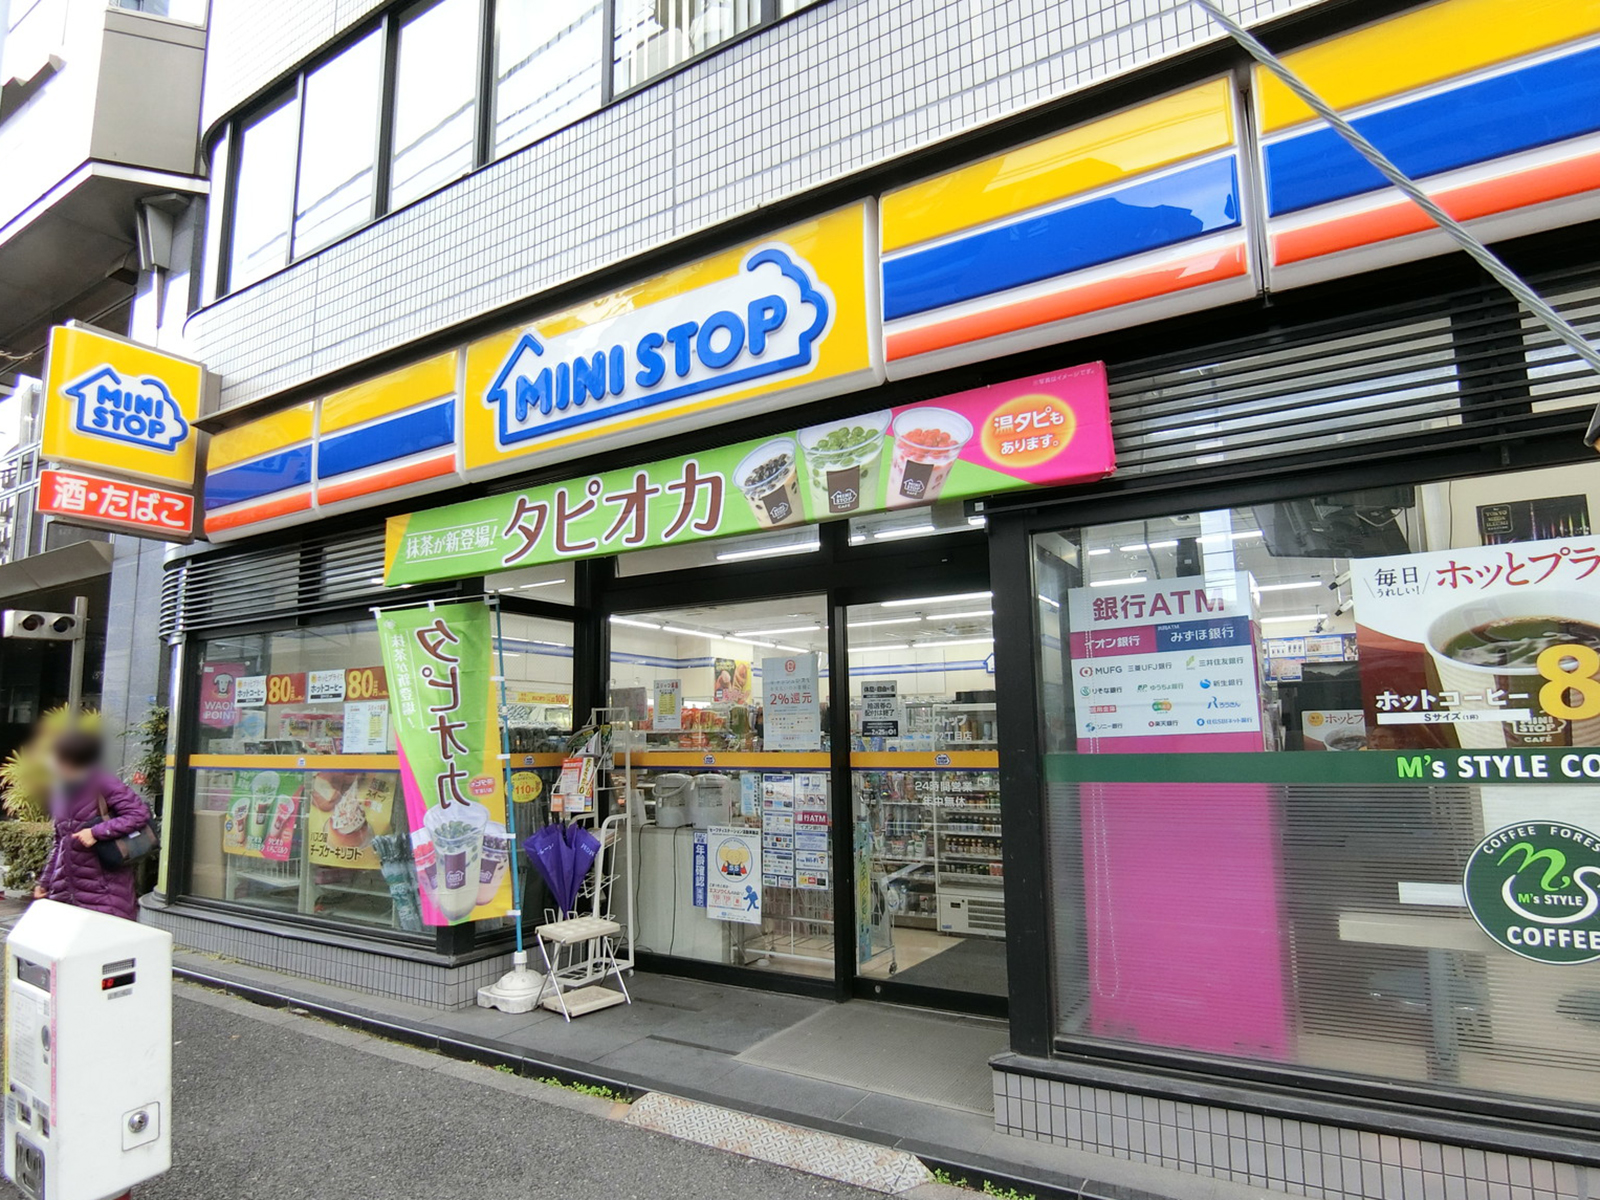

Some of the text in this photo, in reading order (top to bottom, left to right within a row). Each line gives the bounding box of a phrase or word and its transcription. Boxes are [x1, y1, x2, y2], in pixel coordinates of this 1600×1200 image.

[516, 294, 788, 422] MINI STOP
[98, 385, 163, 419] MINI
[93, 406, 165, 438] STOP
[994, 406, 1064, 434] 温タピも
[1001, 434, 1059, 455] あります。
[53, 476, 185, 526] 酒・たばこ
[503, 461, 724, 565] タピオカ
[407, 526, 498, 559] 抹茶が新登場!
[1375, 567, 1418, 587] 毎日
[1377, 586, 1420, 598] うれしい!
[1093, 589, 1224, 622] 銀行ATM
[1084, 636, 1140, 649] イオン銀行
[1170, 627, 1234, 642] みずほ銀行
[1096, 662, 1172, 674] MUFG 三菱UFJ銀行
[237, 689, 264, 697] ホットコーヒー
[268, 676, 291, 703] 80
[311, 684, 343, 693] ホットコーヒー
[348, 670, 374, 698] 80
[770, 692, 812, 705] 2%還元
[1375, 689, 1530, 711] ホットコーヒー
[204, 711, 237, 720] POINT
[1520, 724, 1556, 732] STOP
[1397, 755, 1446, 778] M's
[1457, 755, 1548, 778] STYLE
[915, 781, 973, 792] 24時間営業
[923, 796, 966, 807] 年中無休
[1482, 826, 1536, 854] COFFEE
[310, 844, 362, 860] チーズケーキソフト
[1518, 894, 1583, 906] M's STYLE
[1506, 925, 1600, 950] COFFEE
